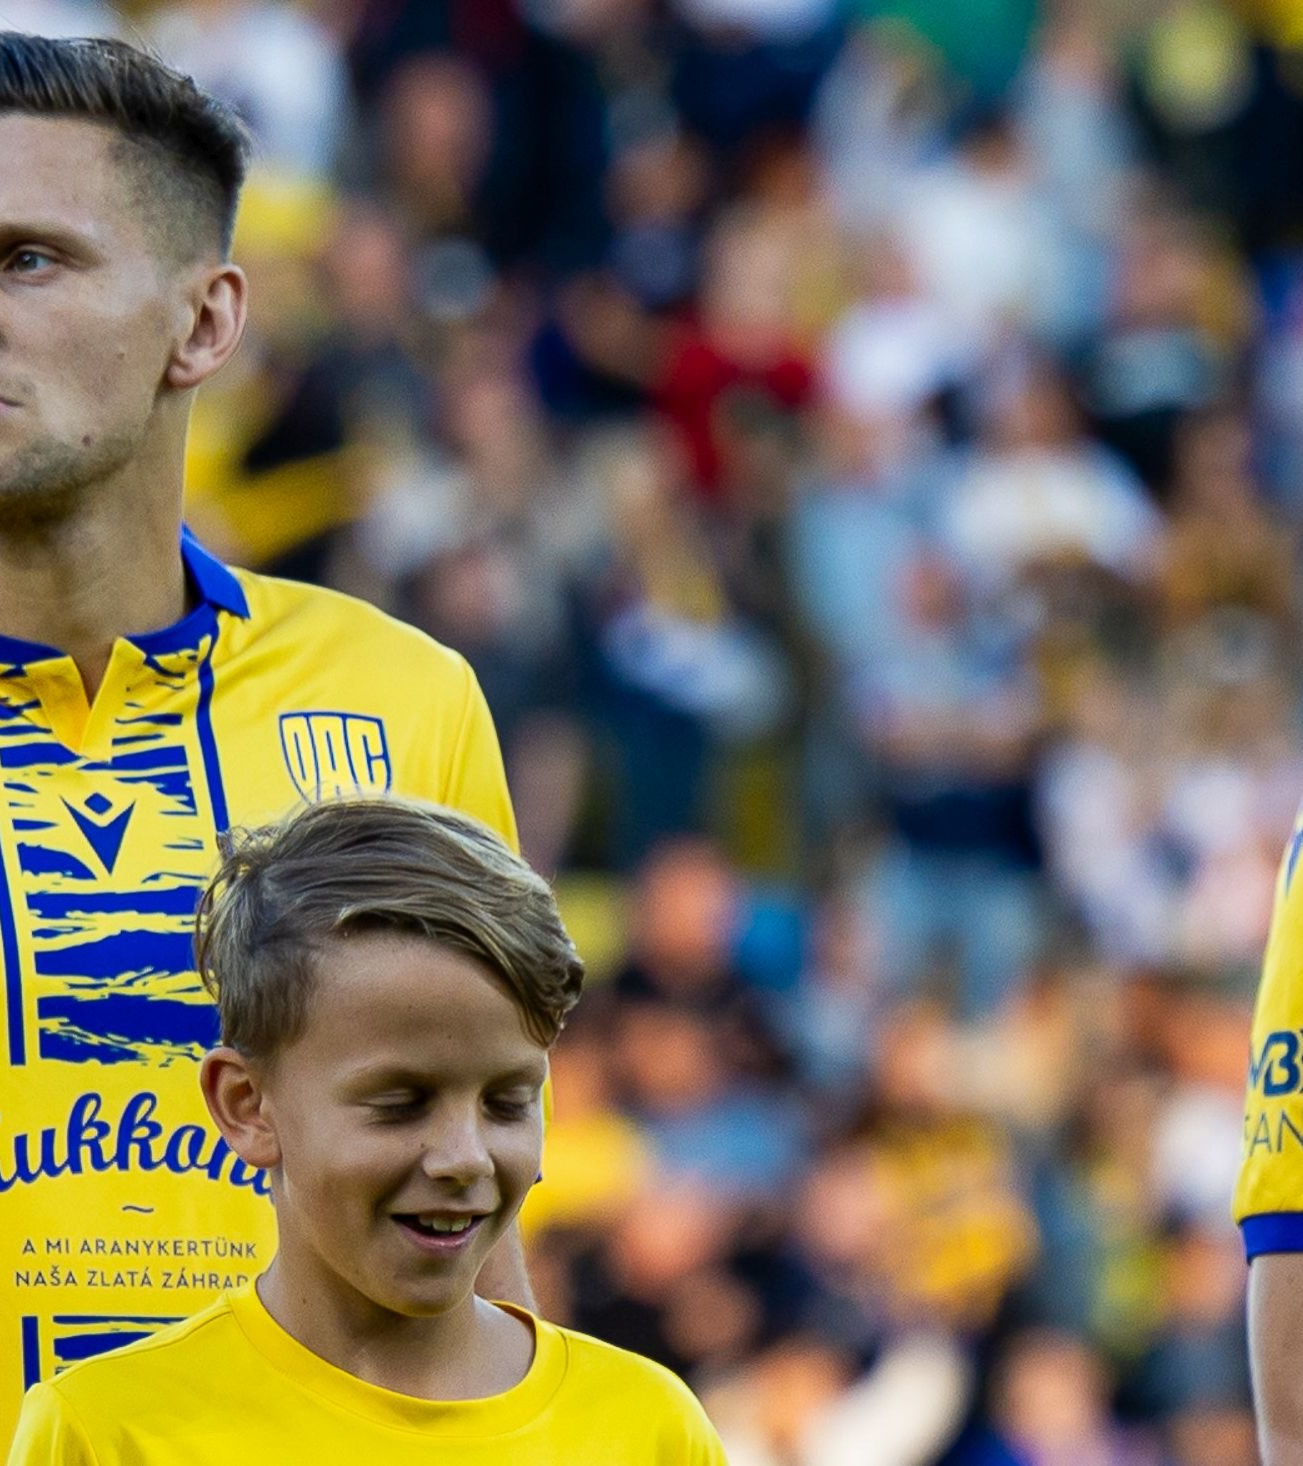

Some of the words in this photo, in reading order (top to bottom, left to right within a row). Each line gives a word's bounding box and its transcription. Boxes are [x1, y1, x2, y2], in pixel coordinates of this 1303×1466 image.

[22, 1237, 37, 1255] A
[45, 1237, 71, 1255] MI
[80, 1236, 257, 1258] ARANYKERTÜNK
[14, 1264, 78, 1288] NAŠA
[86, 1265, 153, 1288] ZLATÁ
[161, 1266, 249, 1290] ZÁHRAD
